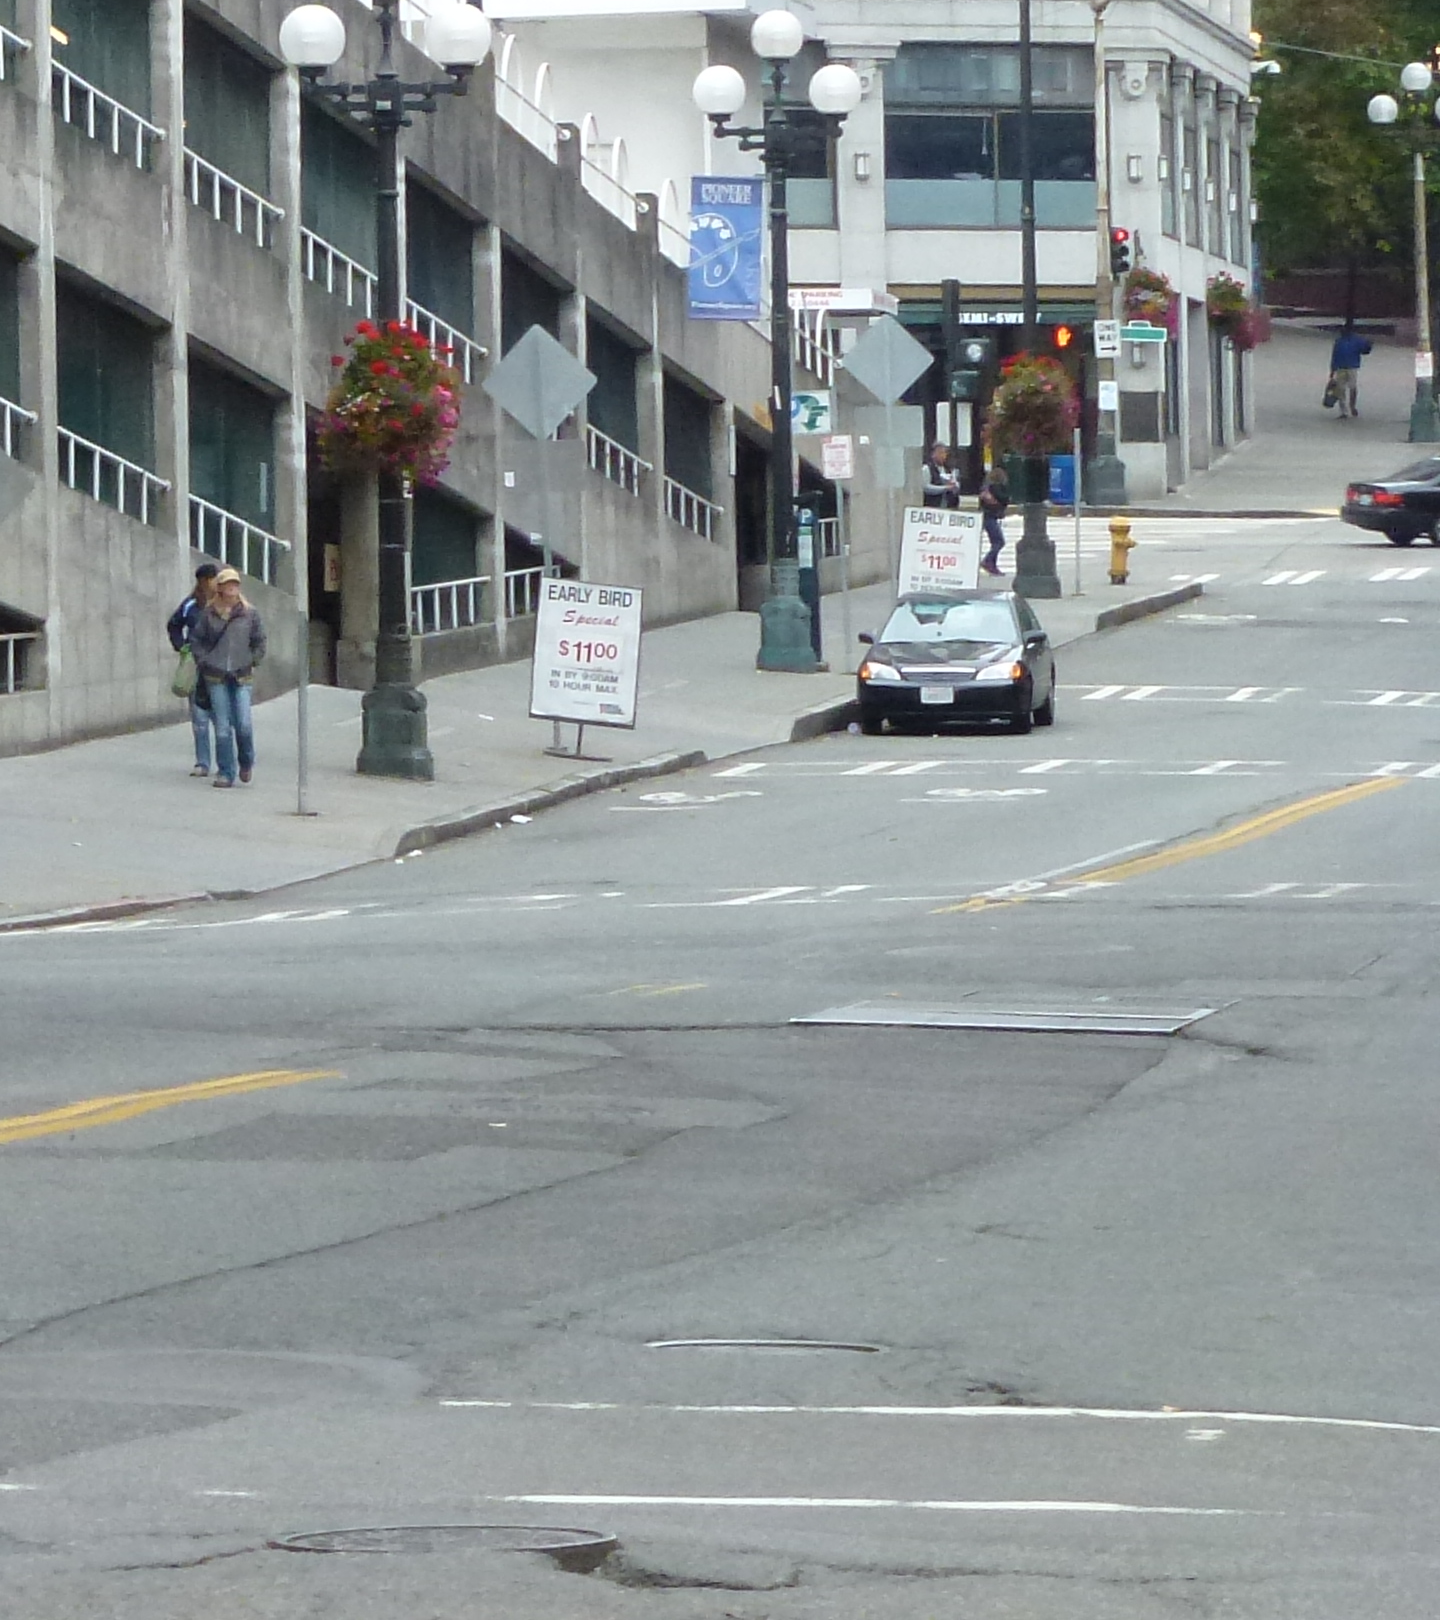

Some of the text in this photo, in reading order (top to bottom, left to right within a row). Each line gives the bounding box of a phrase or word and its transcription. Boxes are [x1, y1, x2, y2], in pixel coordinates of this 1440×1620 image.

[701, 183, 752, 194] PIONEER
[701, 192, 752, 204] SQUARE
[1100, 323, 1117, 332] ONE
[1099, 333, 1118, 341] WAY
[910, 510, 975, 529] EARLY BIRD
[917, 531, 964, 545] Special
[548, 584, 633, 608] EARLY BIRD
[562, 609, 619, 626] Special
